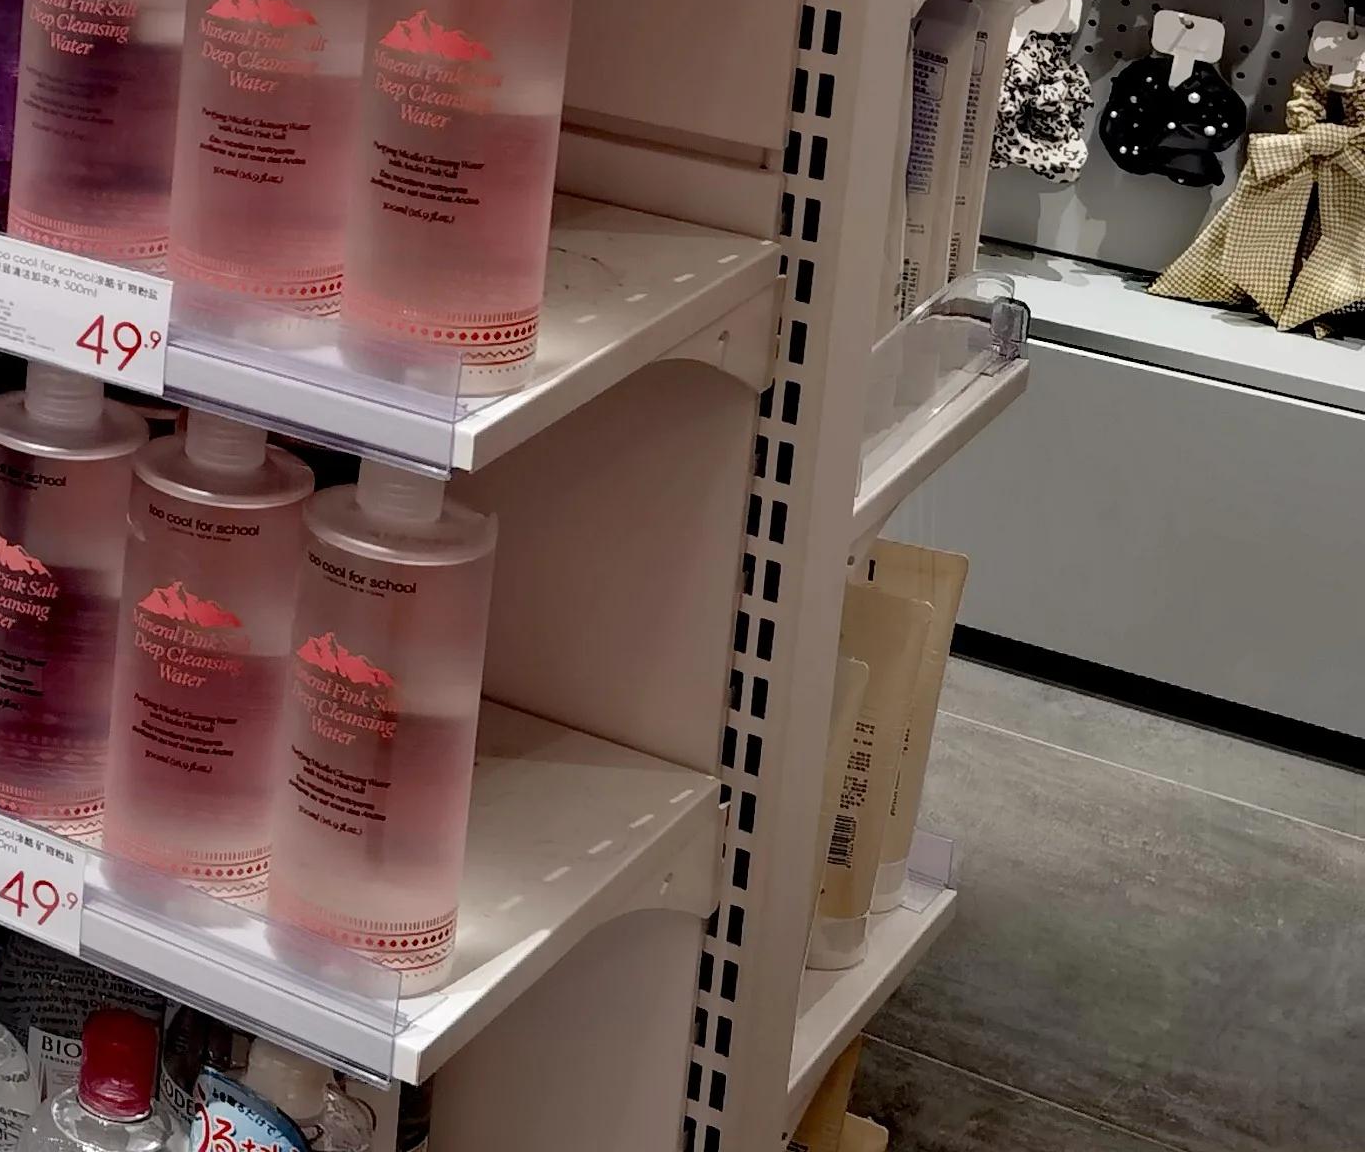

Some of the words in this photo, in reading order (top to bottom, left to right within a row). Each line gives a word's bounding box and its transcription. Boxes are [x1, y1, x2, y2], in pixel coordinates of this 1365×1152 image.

[56, 13, 130, 43] Cleansing
[228, 69, 279, 95] Water
[398, 103, 451, 130] Water
[148, 503, 165, 521] too
[166, 512, 193, 529] cool
[195, 518, 214, 534] for
[216, 522, 260, 537] school
[322, 559, 346, 577] cool
[348, 568, 368, 584] for
[369, 575, 417, 595] school
[158, 665, 206, 690] Water
[310, 715, 356, 745] Water
[319, 703, 397, 739] Cleansing
